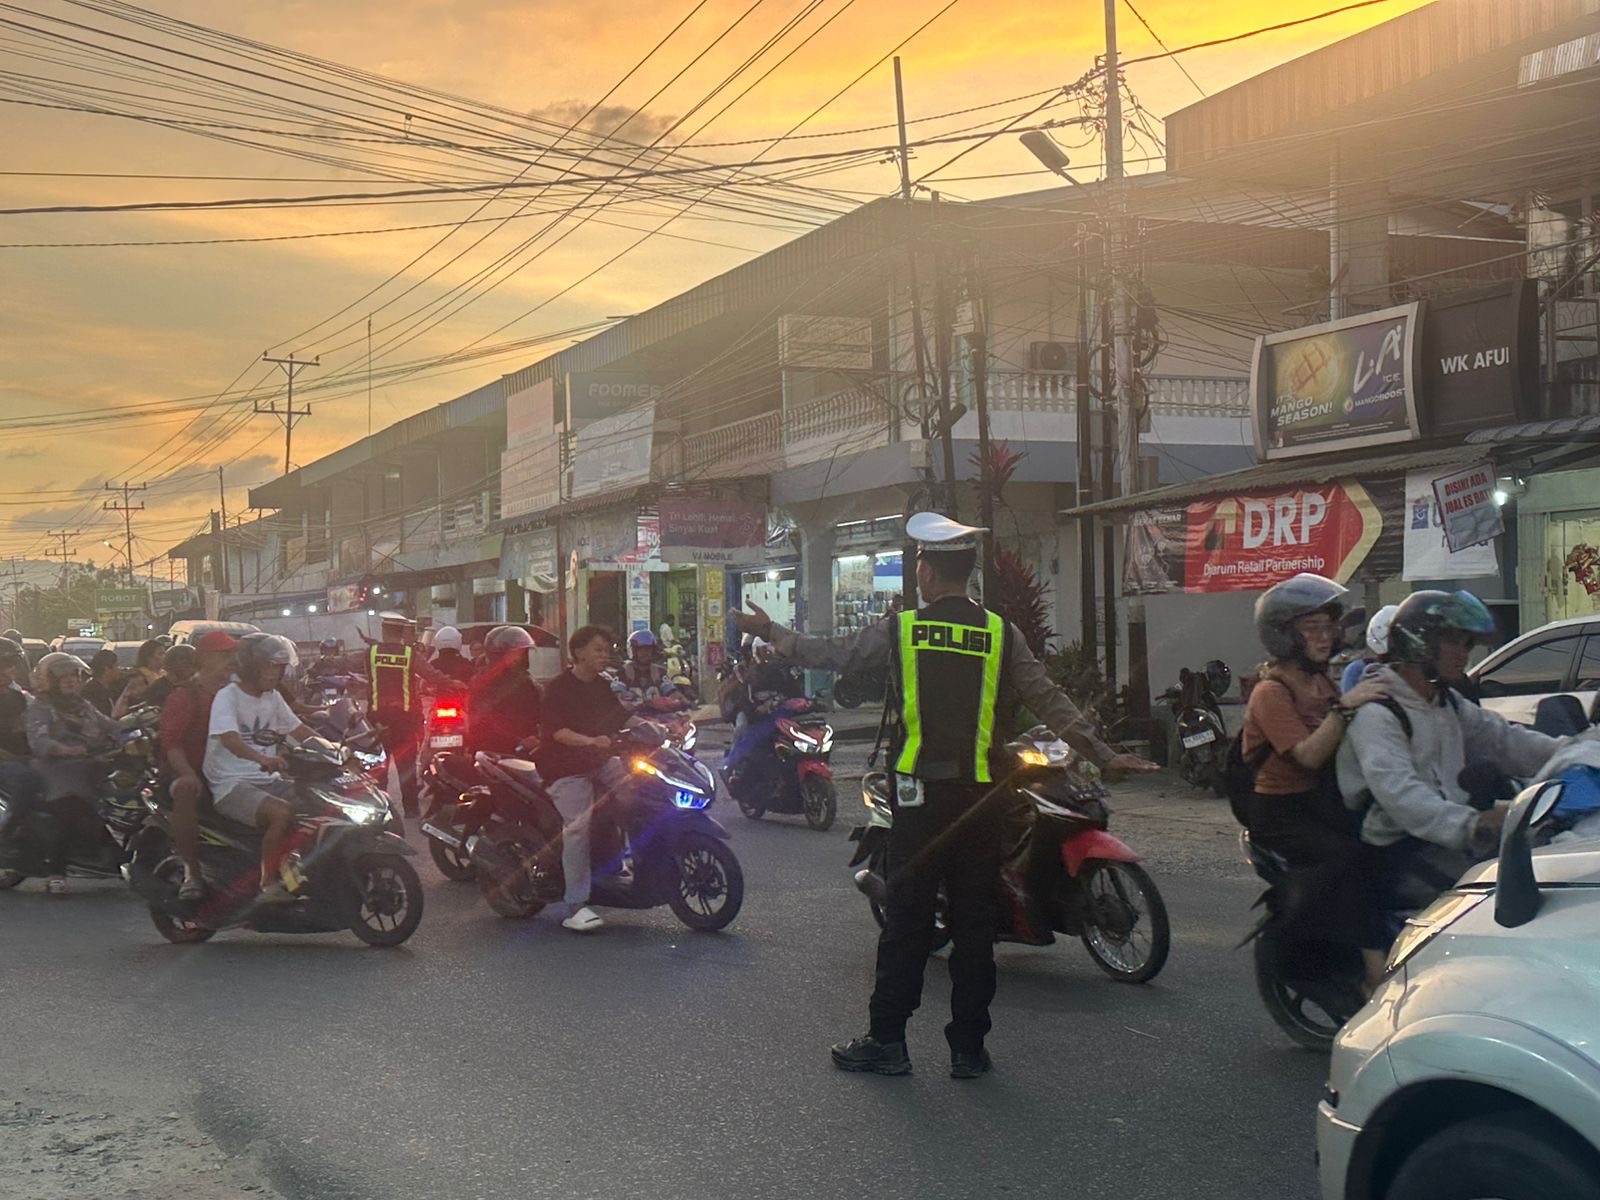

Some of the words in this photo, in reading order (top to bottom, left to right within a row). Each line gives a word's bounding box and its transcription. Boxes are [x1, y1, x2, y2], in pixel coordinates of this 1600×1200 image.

[1440, 353, 1470, 375] WK
[1382, 372, 1401, 383] ICE
[1270, 396, 1313, 418] MANGO
[1277, 402, 1333, 427] SEASON!
[1444, 479, 1470, 497] DISINI
[1470, 472, 1488, 488] ADA
[1445, 497, 1464, 514] JUAL
[1464, 494, 1475, 506] ES
[1242, 492, 1327, 549] DRP
[703, 551, 733, 561] MOBILE
[1203, 562, 1237, 579] Djarum
[1237, 559, 1265, 574] Retail
[1265, 555, 1325, 573] Partnership
[100, 594, 137, 602] ROBOT
[911, 624, 993, 654] POLISI
[375, 655, 408, 666] POLISI
